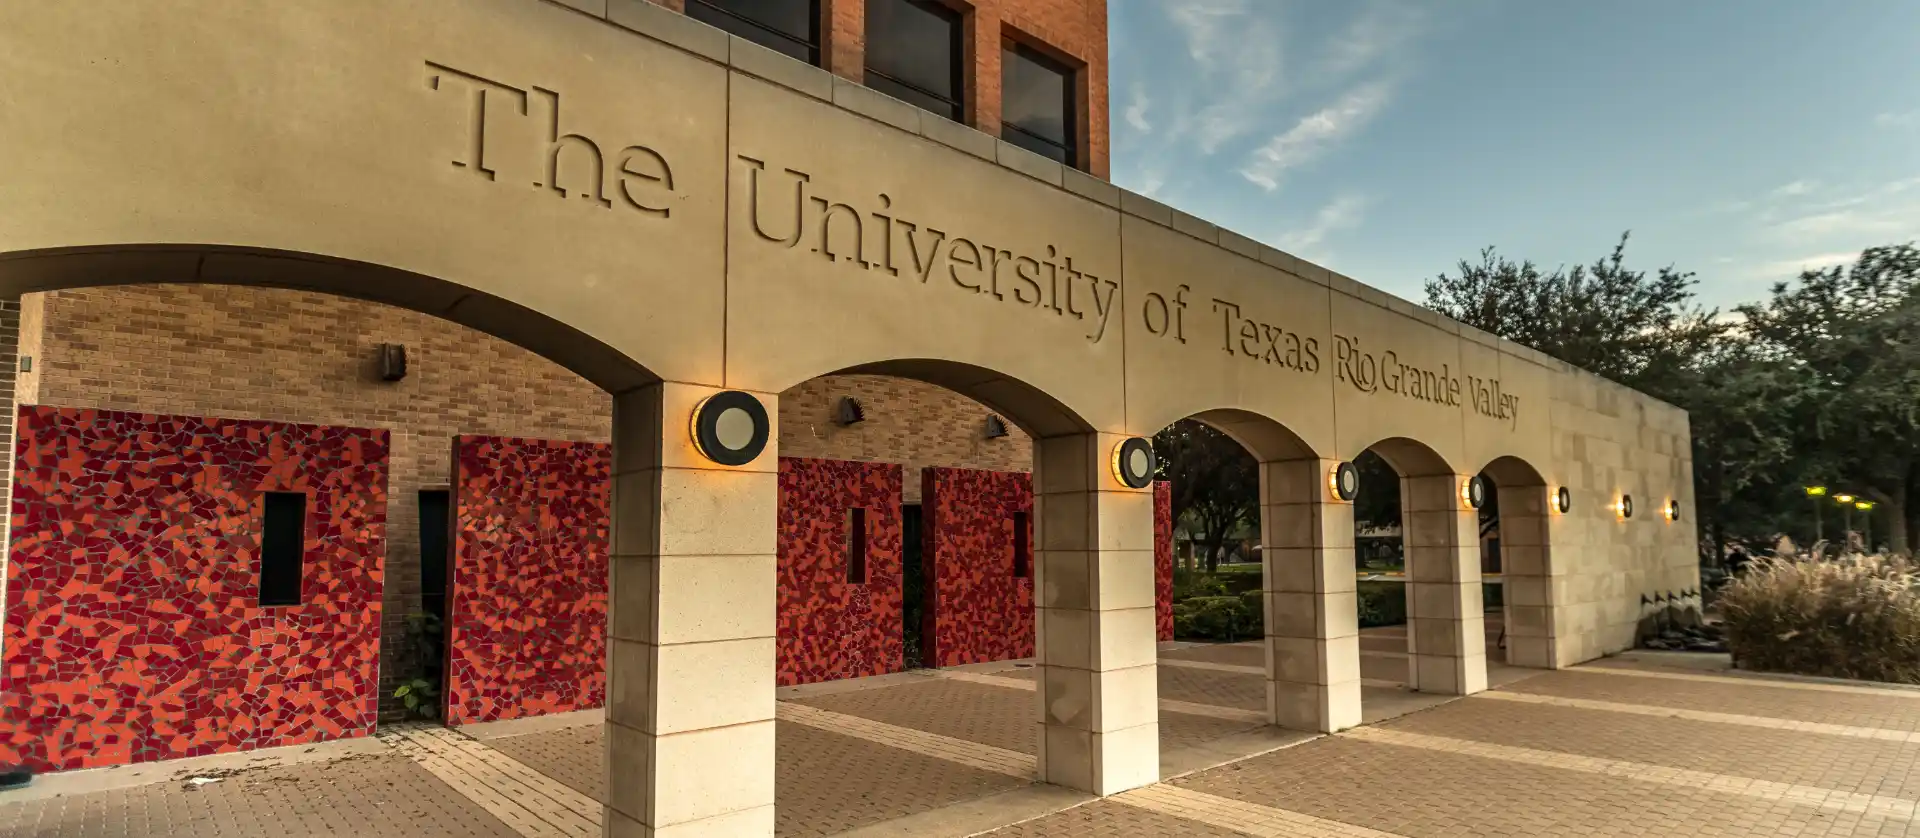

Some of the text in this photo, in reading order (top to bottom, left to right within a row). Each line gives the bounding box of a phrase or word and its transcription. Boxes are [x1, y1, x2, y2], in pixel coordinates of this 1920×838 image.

[424, 60, 1519, 432] The University of Texas Rio Grande Valley
